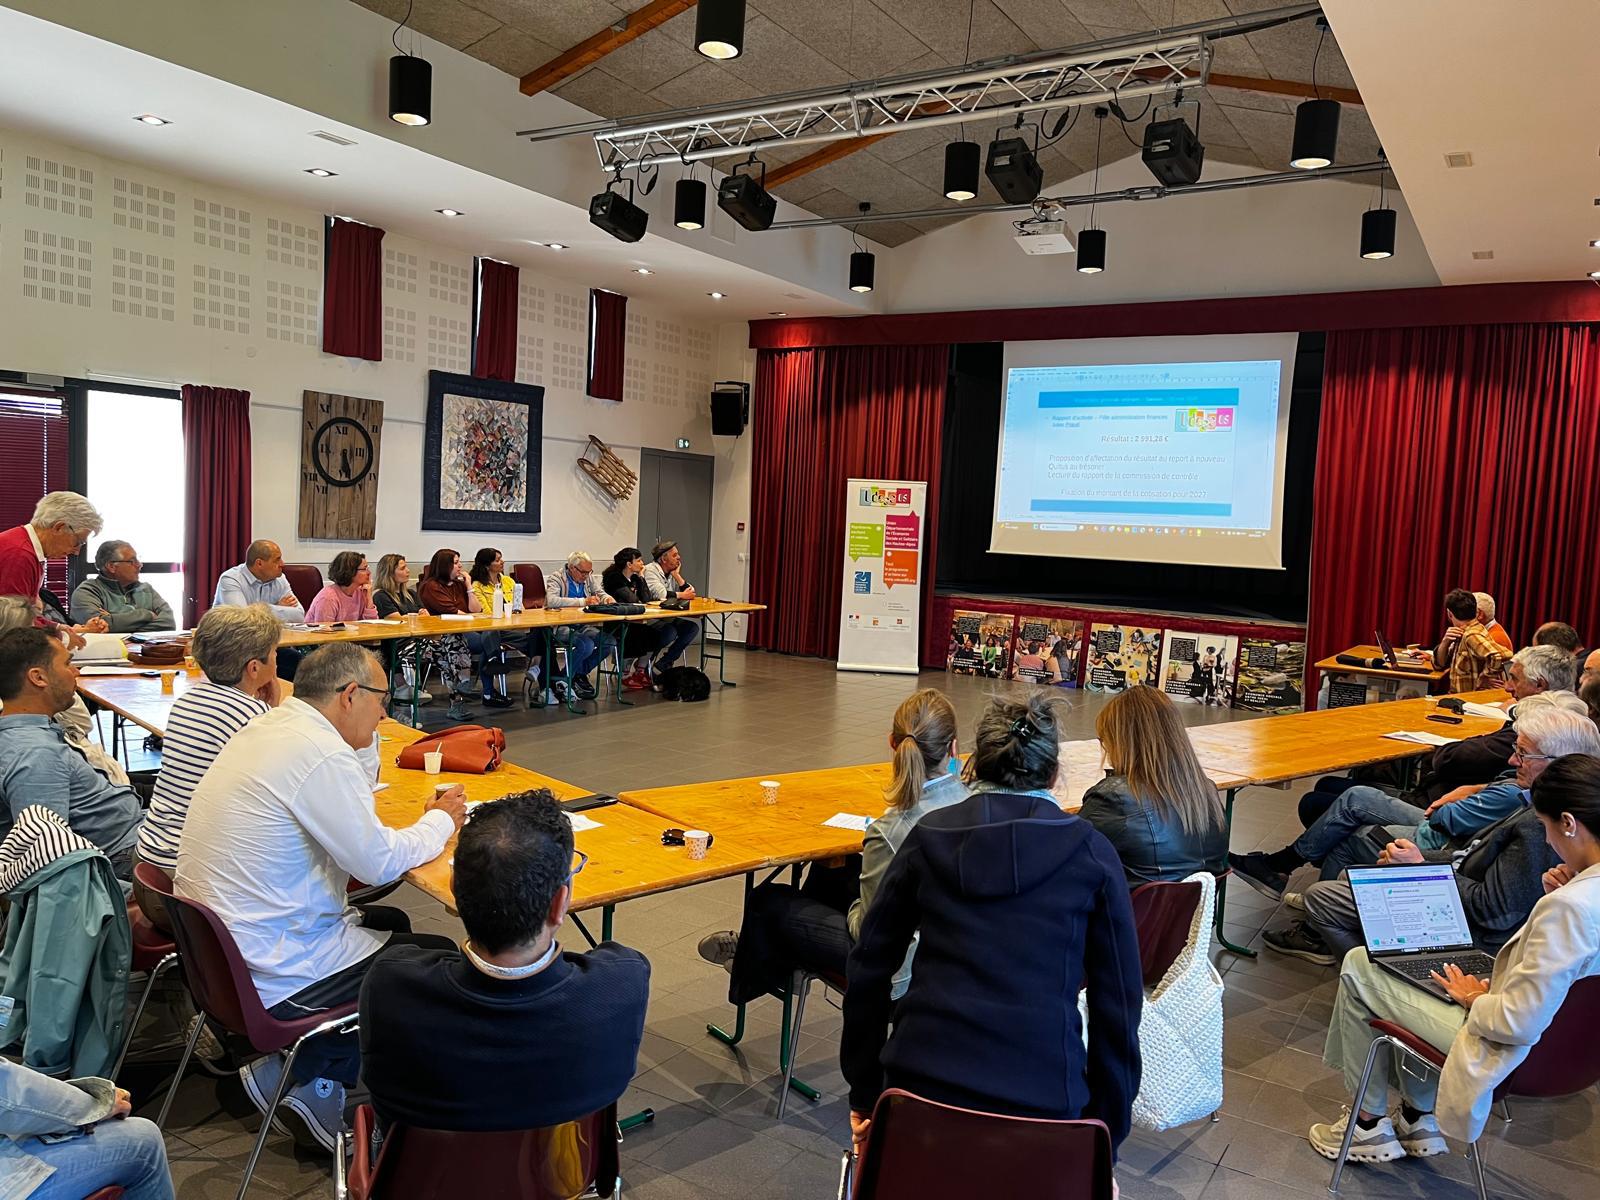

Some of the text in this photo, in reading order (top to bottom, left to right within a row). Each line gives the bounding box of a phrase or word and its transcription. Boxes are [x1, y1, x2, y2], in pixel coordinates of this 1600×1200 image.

[320, 404, 330, 414] XI
[307, 421, 314, 430] X
[372, 425, 378, 434] II
[335, 426, 348, 436] XII
[1101, 434, 1129, 443] Résultat
[355, 448, 364, 458] III
[1049, 454, 1083, 462] Proposition
[1082, 472, 1104, 480] rapport
[316, 485, 328, 495] VII
